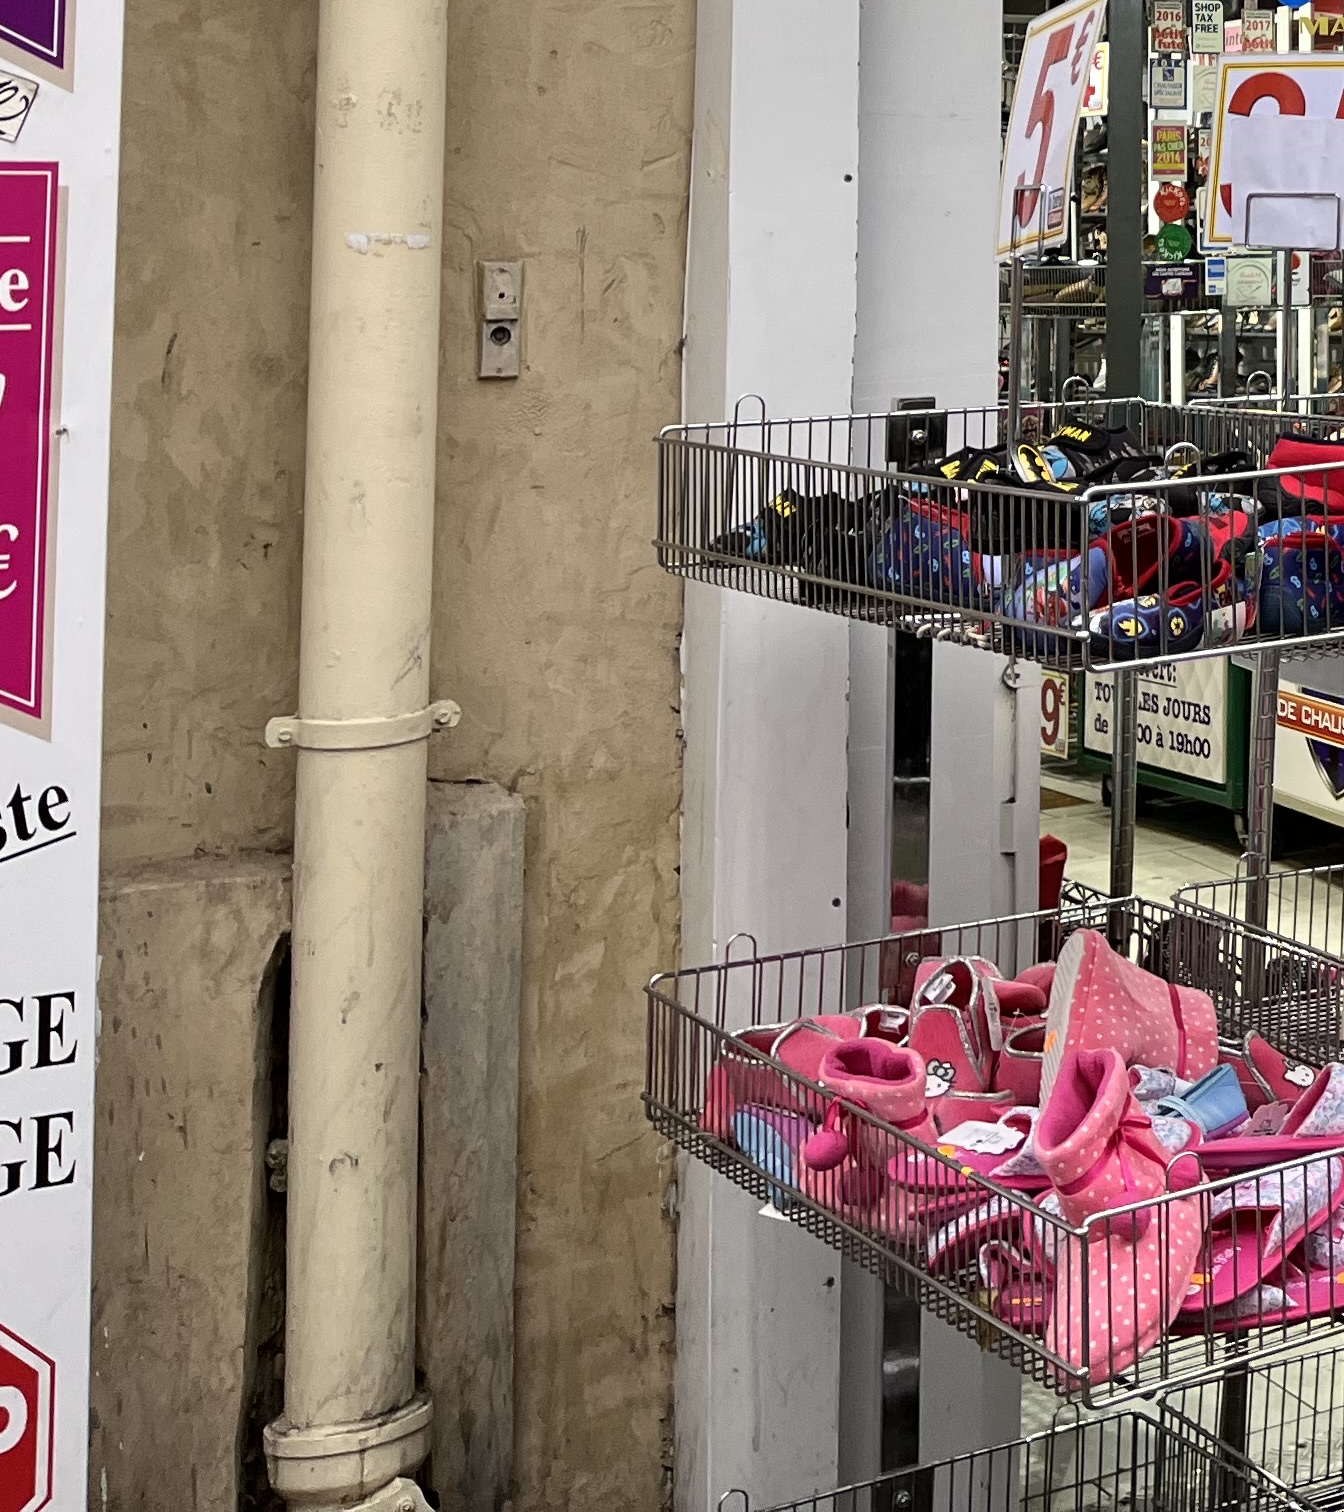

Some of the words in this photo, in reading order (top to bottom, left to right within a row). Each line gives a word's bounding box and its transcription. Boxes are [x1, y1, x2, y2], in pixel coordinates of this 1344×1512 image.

[1194, 2, 1221, 13] SHOP
[1156, 11, 1182, 22] 2016
[1194, 14, 1214, 23] TAX
[1194, 24, 1219, 33] FREE
[1245, 20, 1271, 32] 2017
[1152, 59, 1185, 68] 2014
[1163, 697, 1211, 726] JOURS
[1278, 699, 1297, 721] DE
[1094, 713, 1109, 734] de
[1156, 726, 1164, 748] à
[1169, 730, 1211, 760] 19h00
